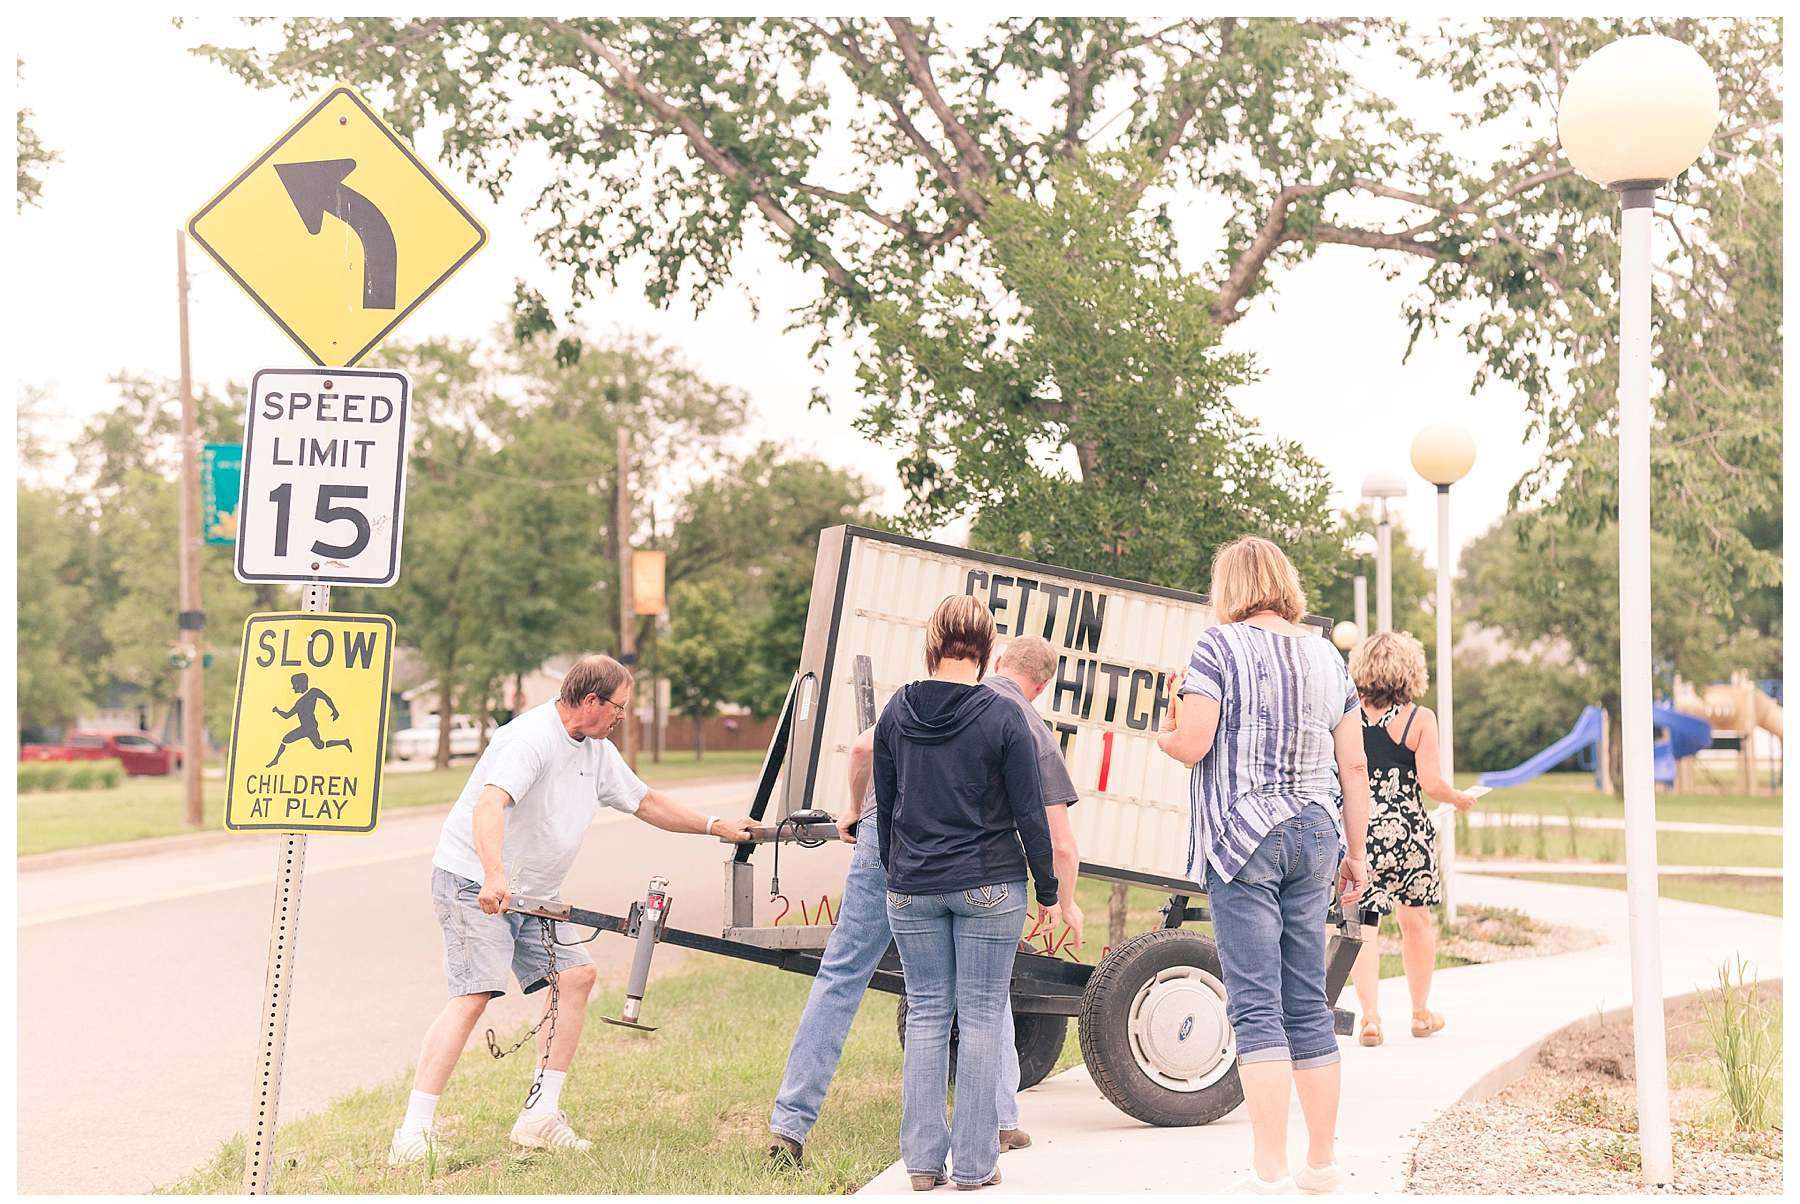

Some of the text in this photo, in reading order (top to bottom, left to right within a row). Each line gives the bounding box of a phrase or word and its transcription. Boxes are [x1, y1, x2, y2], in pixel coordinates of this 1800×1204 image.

[262, 391, 393, 423] SPEED
[272, 437, 376, 469] LIMIT
[268, 482, 371, 560] 15
[255, 628, 378, 669] SLOW
[1043, 719, 1114, 792] T 1
[246, 774, 358, 797] CHILDREN
[250, 797, 348, 820] AT PLAY
